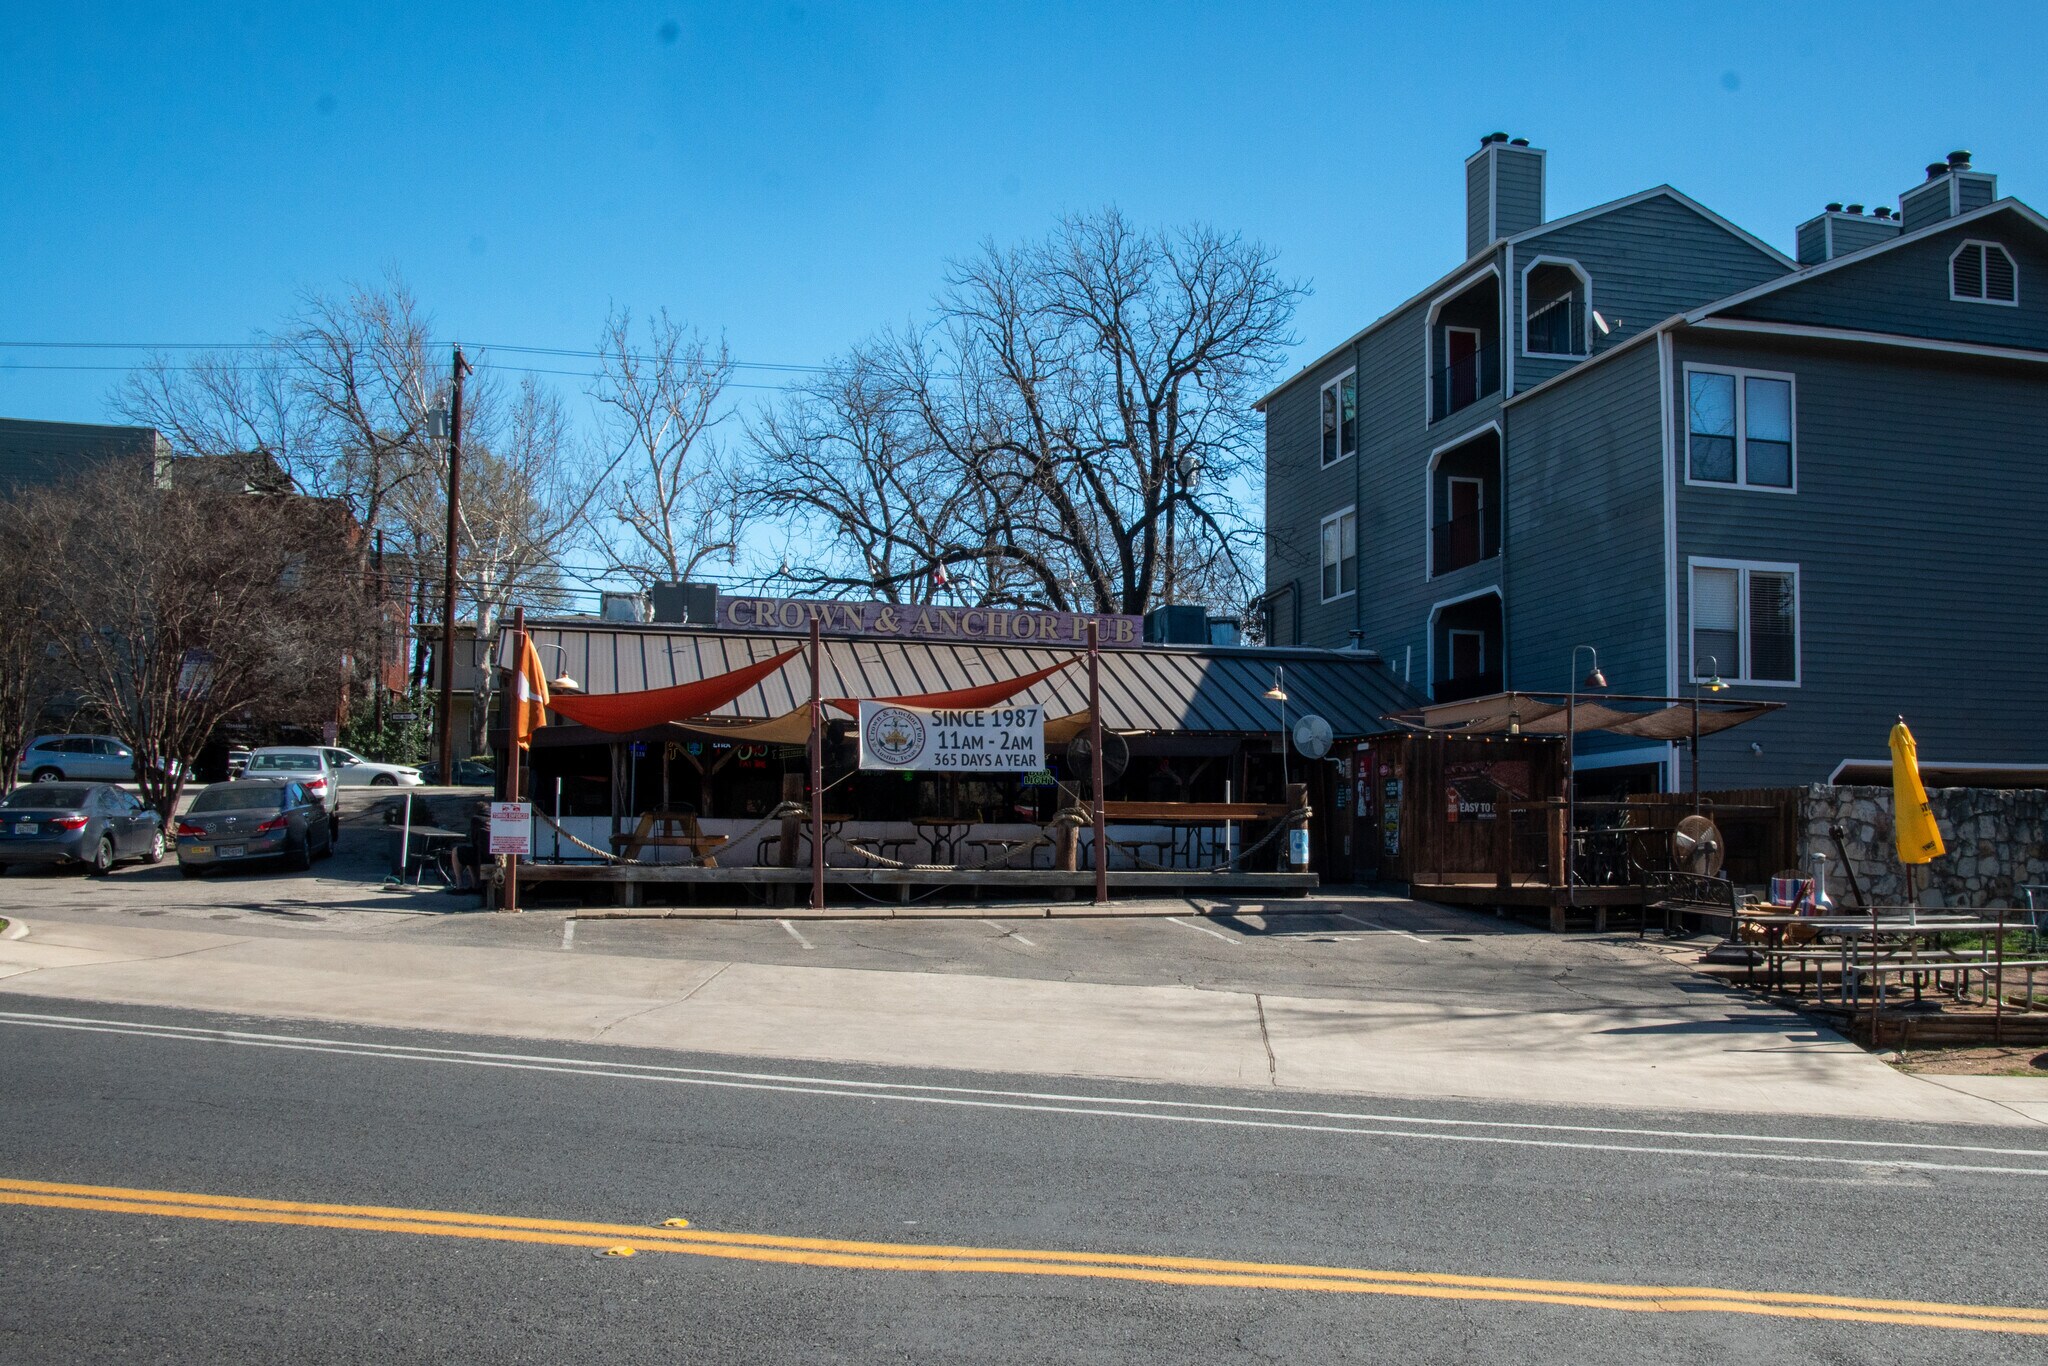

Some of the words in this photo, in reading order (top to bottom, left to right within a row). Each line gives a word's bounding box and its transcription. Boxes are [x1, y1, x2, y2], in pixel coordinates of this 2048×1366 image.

[727, 599, 866, 633] CROWN
[874, 606, 901, 633] &
[911, 608, 1060, 640] ANCHOR
[1070, 616, 1135, 644] PUB
[870, 716, 882, 742] Crown
[892, 710, 919, 726] Anchor
[916, 726, 924, 743] Pub
[931, 710, 985, 728] SINCE
[992, 708, 1038, 728] 1987
[938, 730, 984, 750] 11AM
[1000, 731, 1033, 750] 2AM
[898, 749, 918, 762] Texas
[934, 753, 957, 766] 365
[962, 754, 992, 766] DAYS
[994, 754, 1003, 766] A
[1005, 754, 1037, 767] YEAR
[1024, 776, 1054, 785] LIGHT
[1460, 802, 1479, 813] EASY
[1480, 802, 1491, 812] TO
